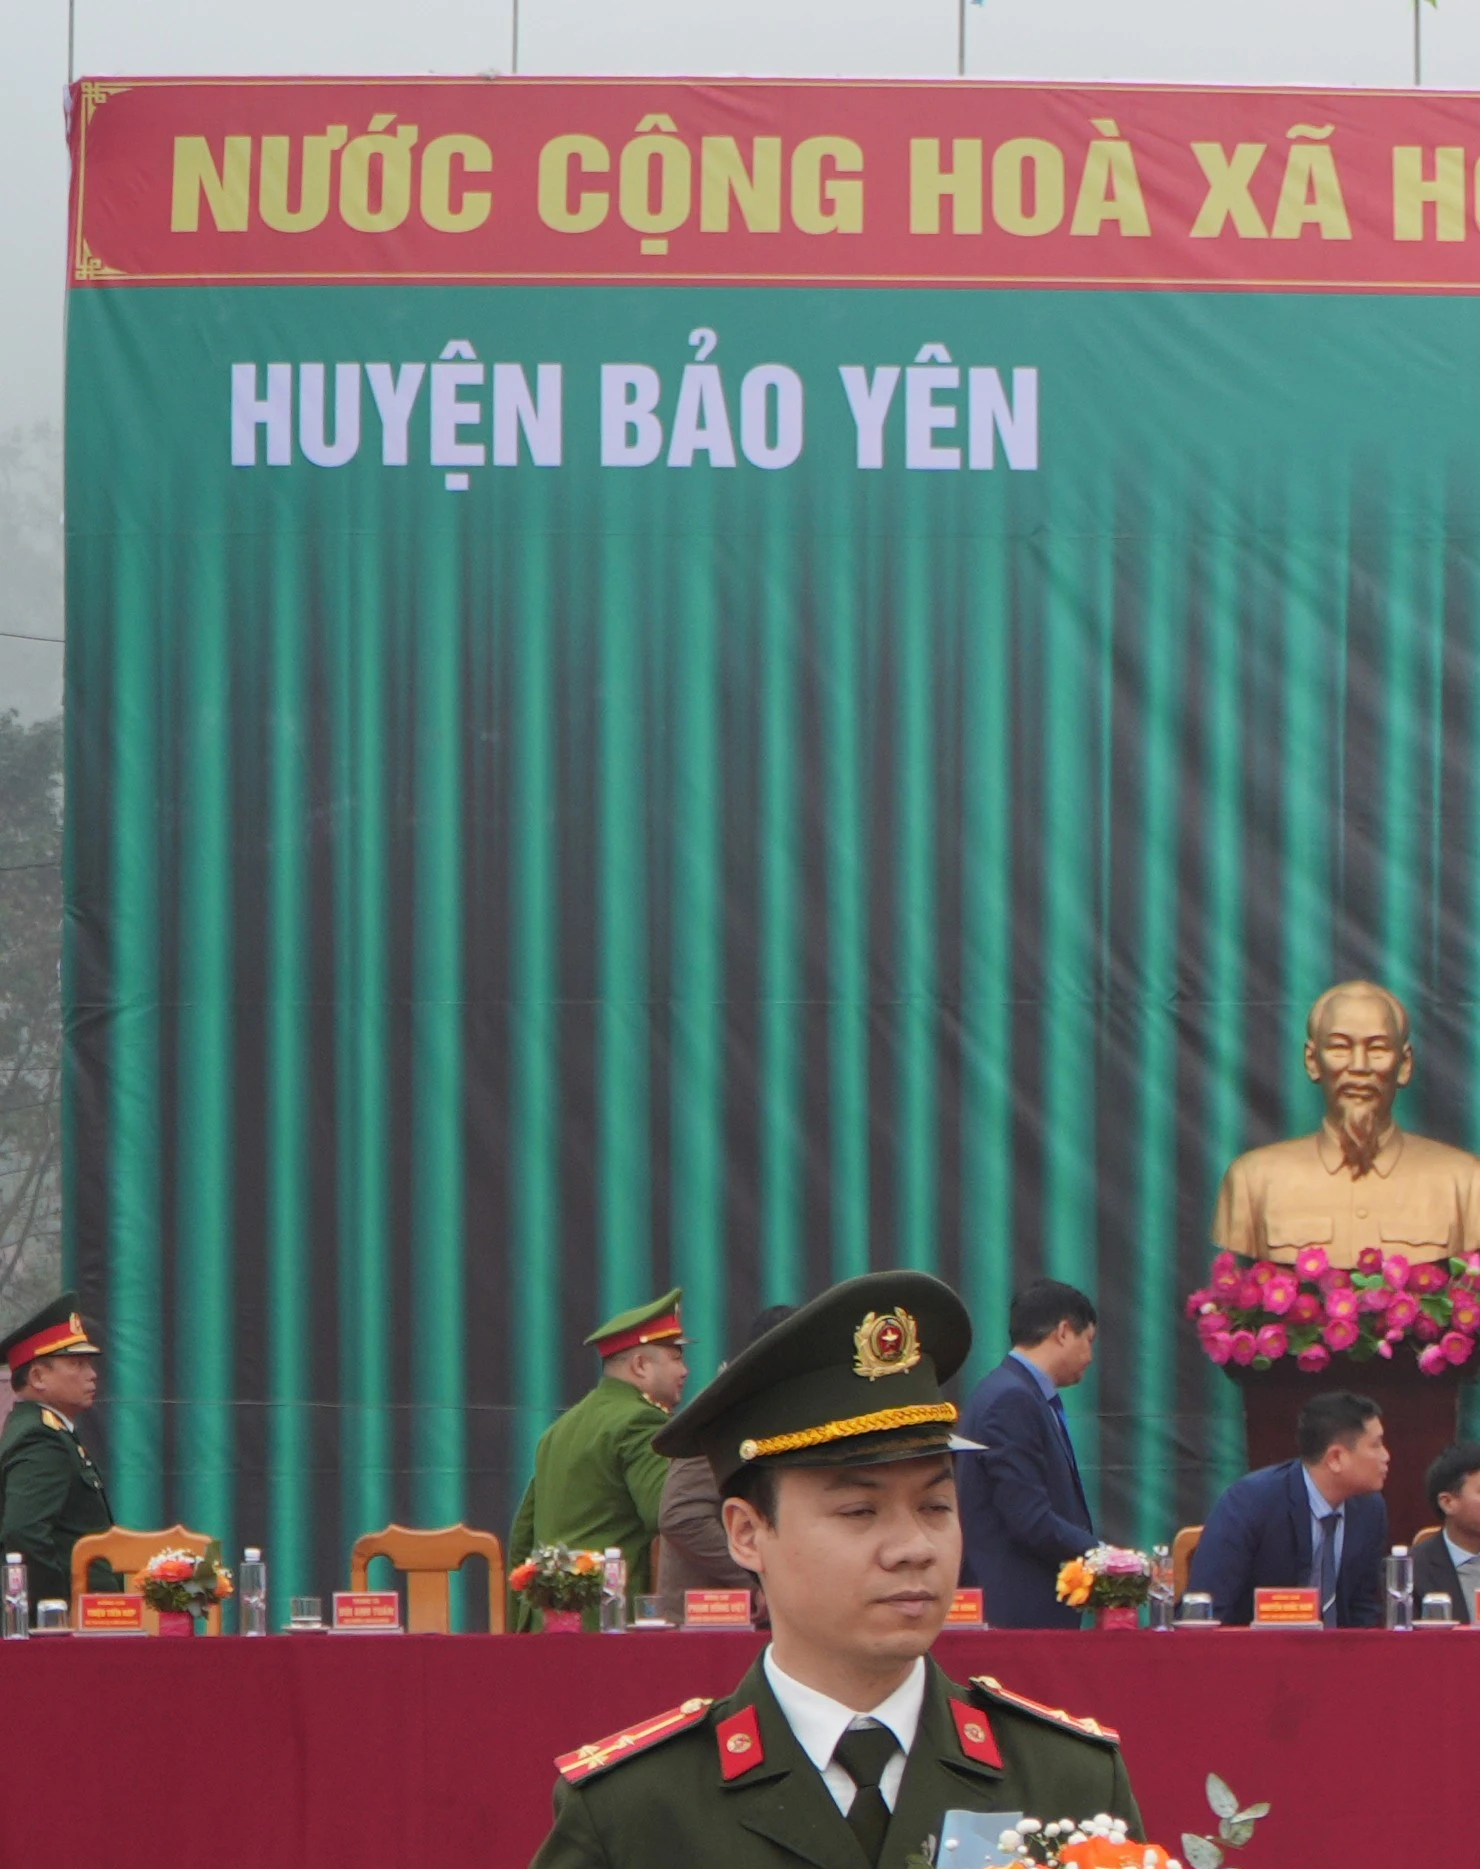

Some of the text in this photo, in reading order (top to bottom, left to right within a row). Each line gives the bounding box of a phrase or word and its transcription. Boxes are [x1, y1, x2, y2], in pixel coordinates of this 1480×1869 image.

[170, 113, 493, 233] NƯỚC
[538, 113, 865, 255] CỘNG
[909, 118, 1151, 237] HOÀ
[1191, 124, 1352, 239] XÃ
[231, 326, 1040, 491] HUYỆN BẢO YÊN
